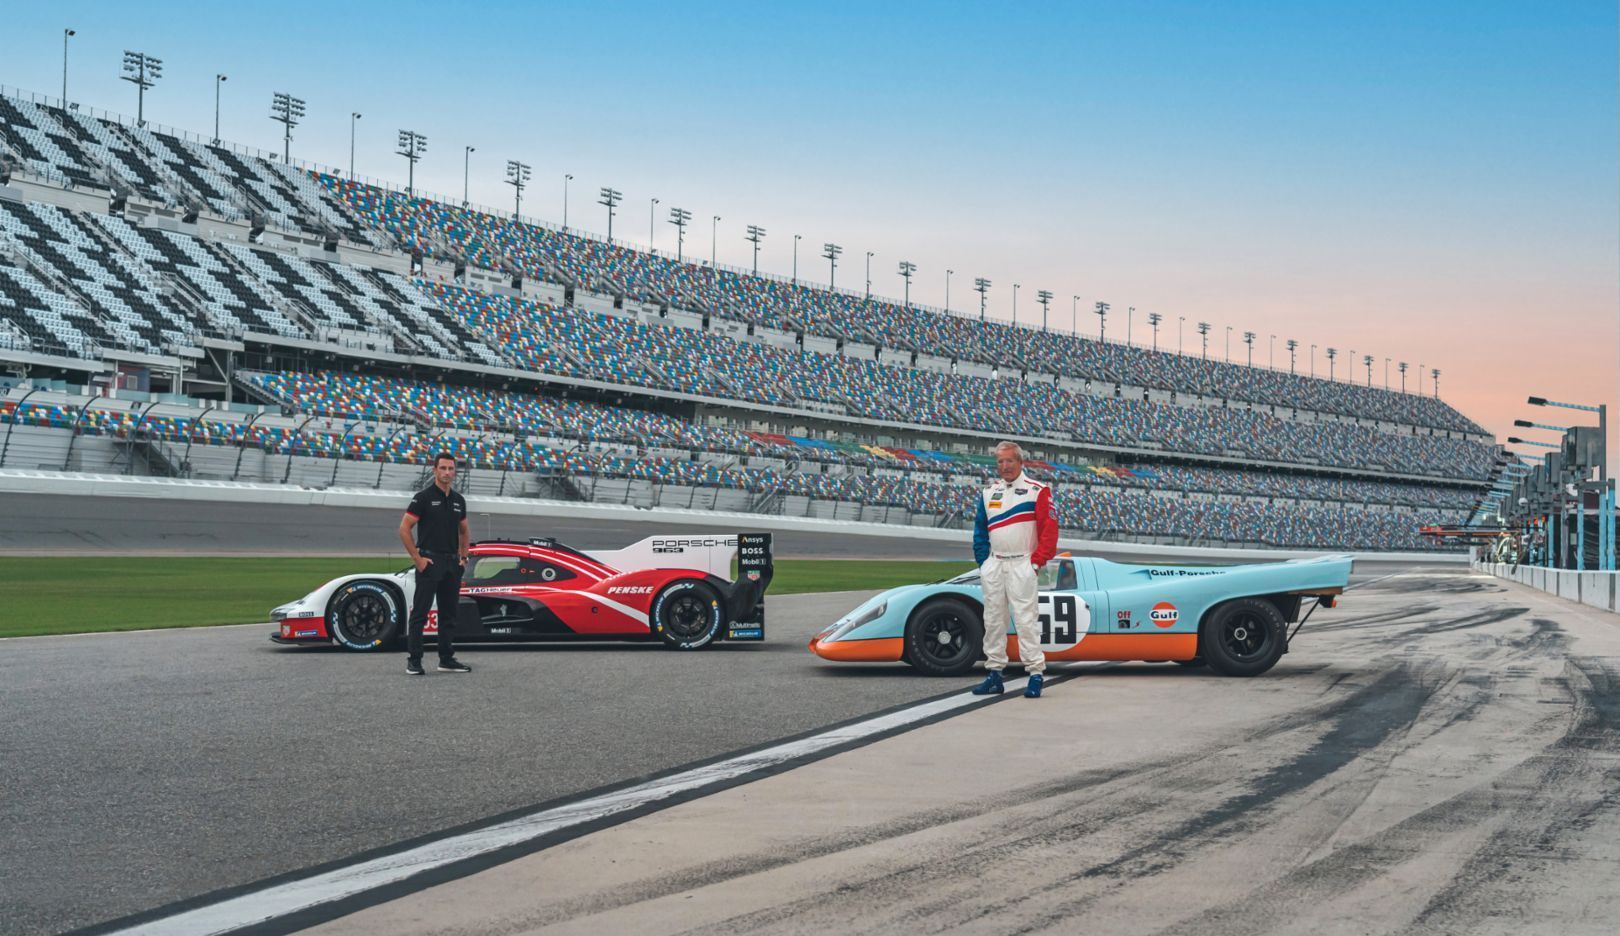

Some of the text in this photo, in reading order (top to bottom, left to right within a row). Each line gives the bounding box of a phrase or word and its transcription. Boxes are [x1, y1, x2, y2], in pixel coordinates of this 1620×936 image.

[652, 539, 738, 547] PORSCHE
[742, 547, 763, 555] BOSS
[607, 586, 654, 594] PENSKE
[1116, 611, 1131, 619] Off
[1150, 611, 1177, 620] Gulf
